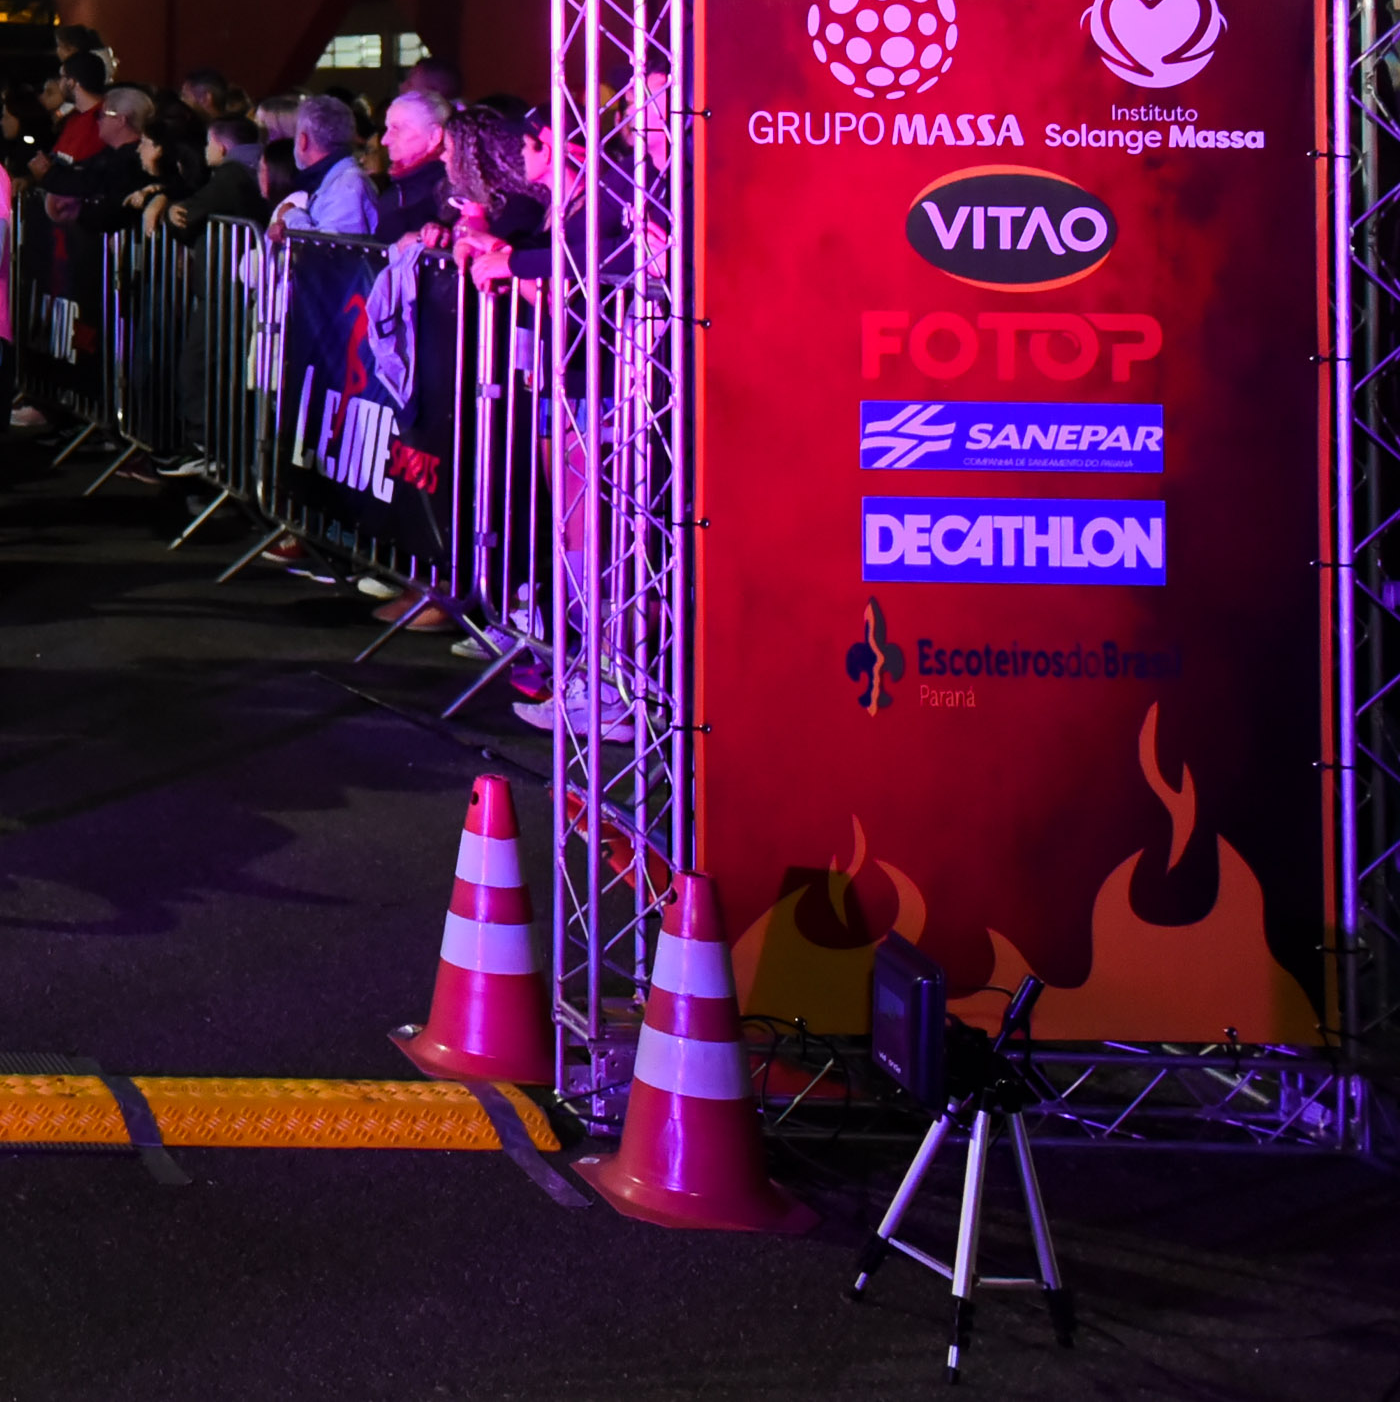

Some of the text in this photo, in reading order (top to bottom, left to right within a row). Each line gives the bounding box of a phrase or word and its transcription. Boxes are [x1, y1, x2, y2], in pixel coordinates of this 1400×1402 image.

[747, 110, 1025, 147] GRUPO MASSA
[1110, 103, 1199, 123] Instituto
[1044, 122, 1266, 155] Solange Massa
[859, 310, 1164, 383] FOTOP
[964, 422, 1164, 452] SANEPAR
[864, 513, 1164, 568] DECATHLON
[918, 684, 976, 709] Paraná
